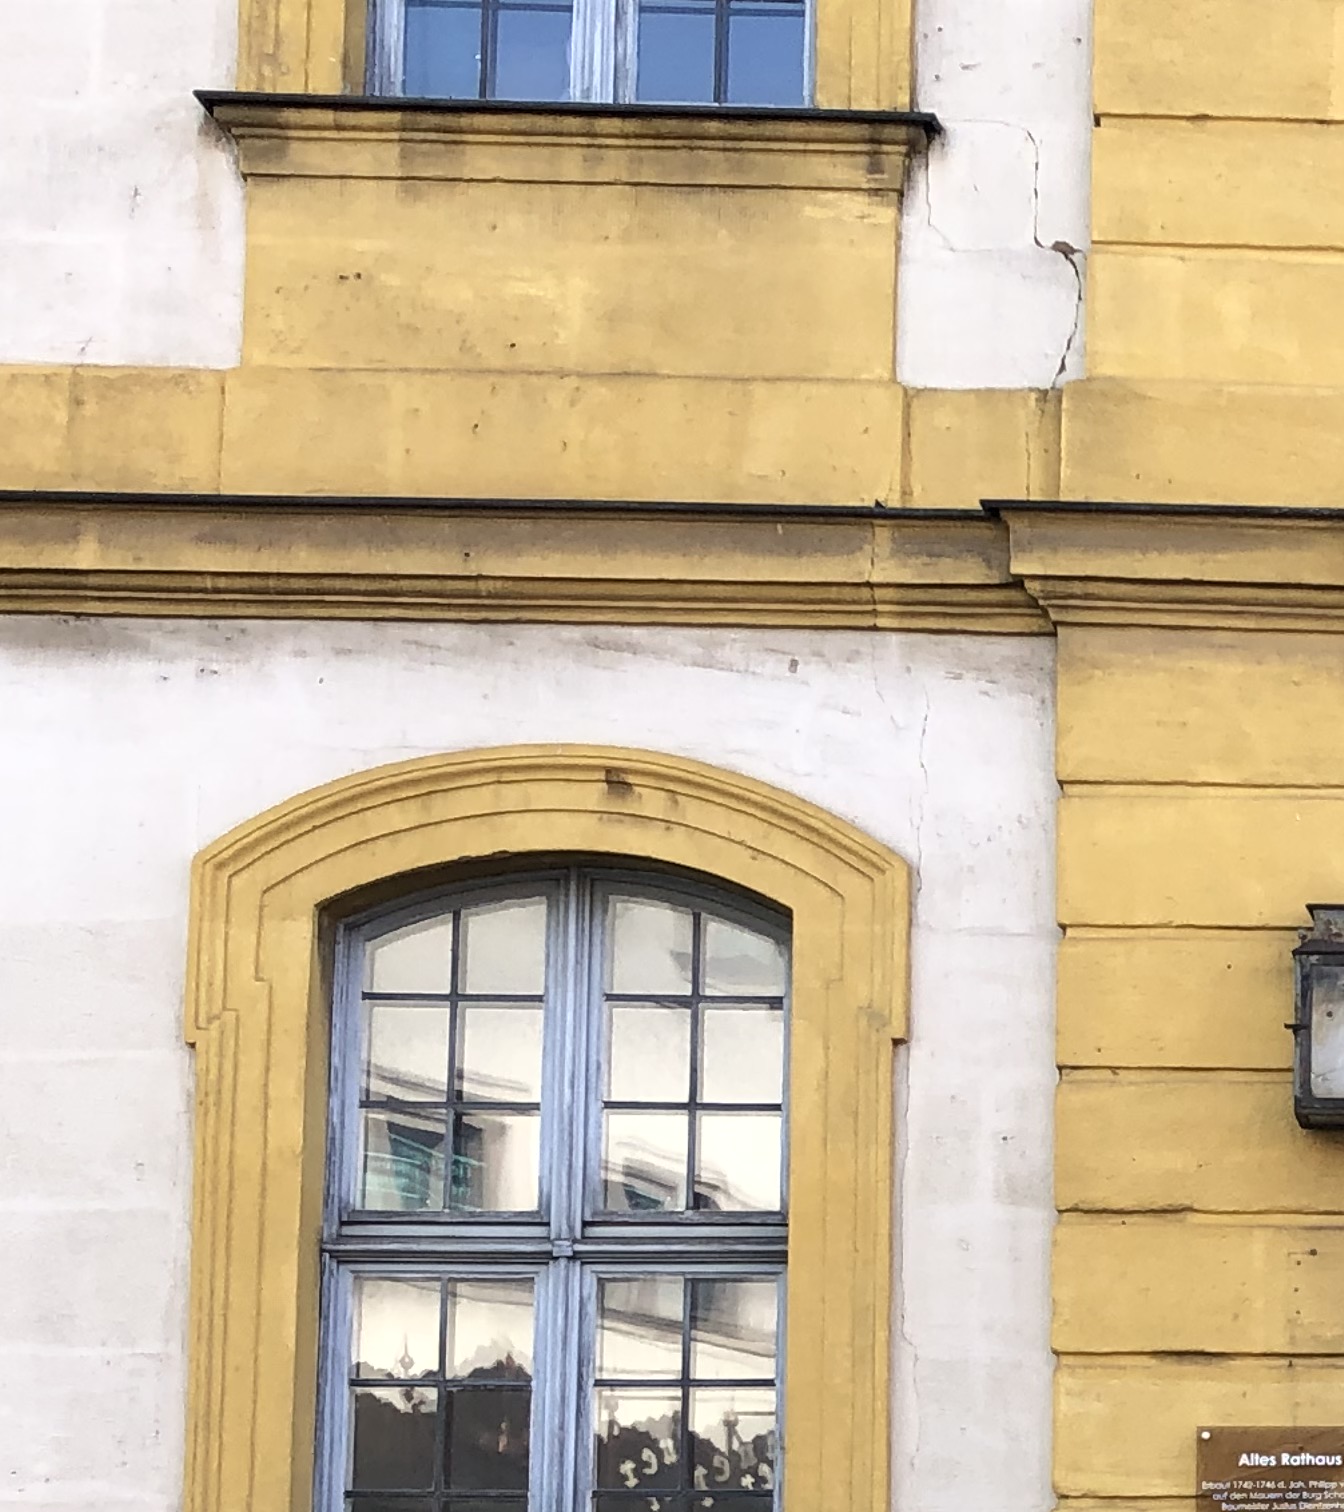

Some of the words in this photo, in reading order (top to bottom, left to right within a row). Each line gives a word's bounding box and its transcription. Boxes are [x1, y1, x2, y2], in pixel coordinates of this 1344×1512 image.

[1238, 1452, 1276, 1467] Altes
[1281, 1452, 1343, 1467] Rathaus
[1308, 1480, 1338, 1489] Philipp
[1212, 1491, 1228, 1500] auf
[1285, 1491, 1301, 1499] der
[1302, 1491, 1322, 1500] Burg
[1221, 1502, 1269, 1511] Baumeister
